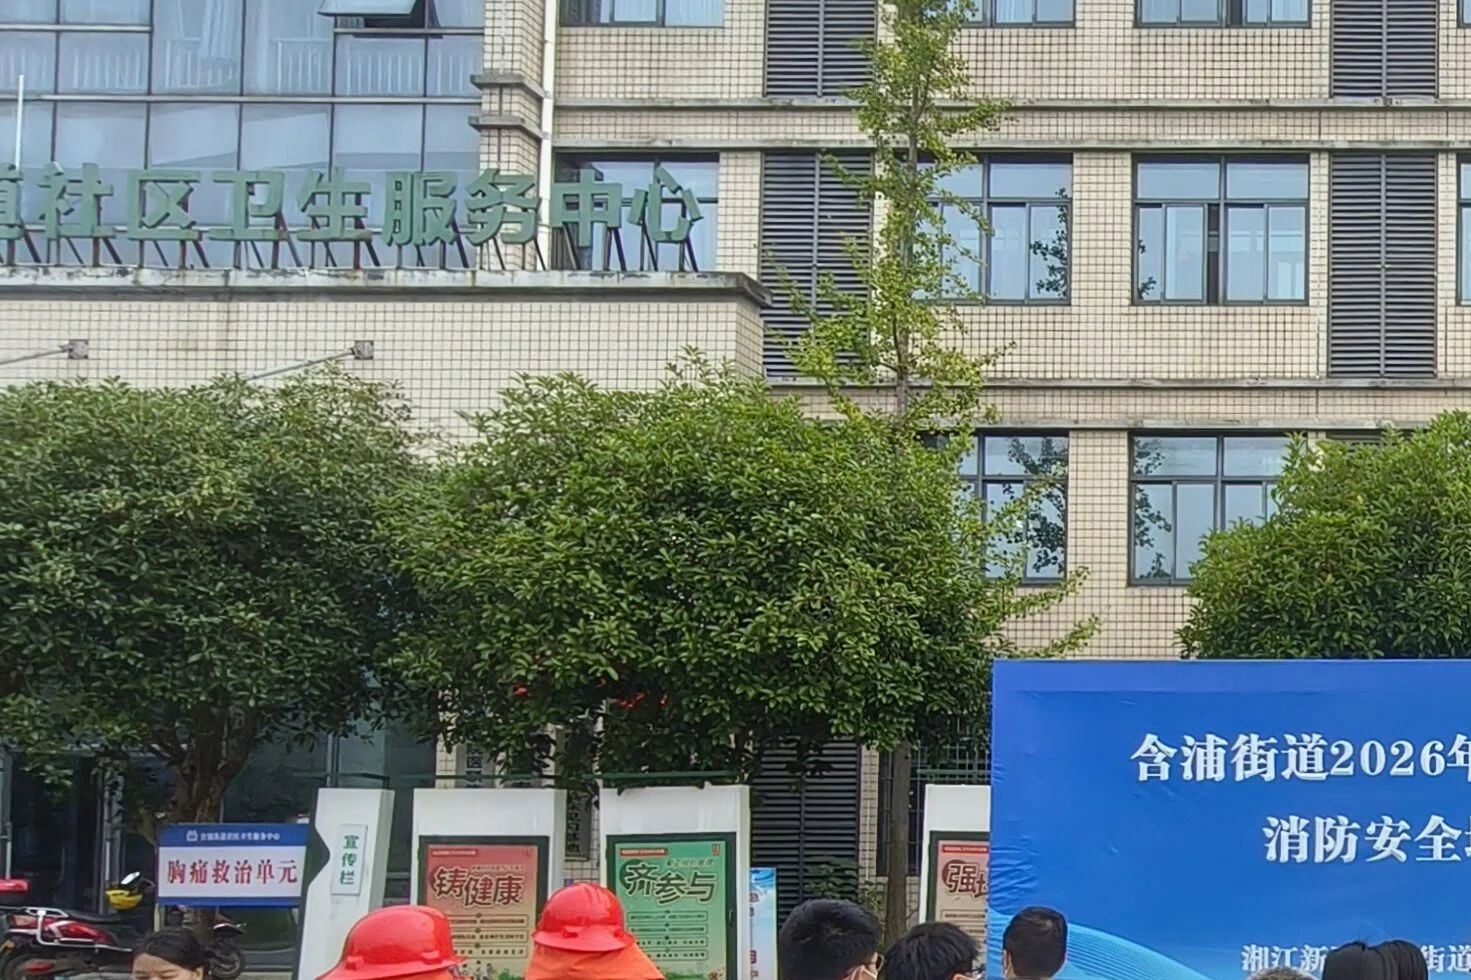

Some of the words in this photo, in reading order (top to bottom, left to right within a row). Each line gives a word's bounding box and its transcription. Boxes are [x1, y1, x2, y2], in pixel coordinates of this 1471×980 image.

[167, 859, 298, 885] 胸痛救治单元
[341, 834, 360, 885] 宣传栏
[433, 867, 525, 907] 铸健康
[626, 863, 716, 904] 齐参与
